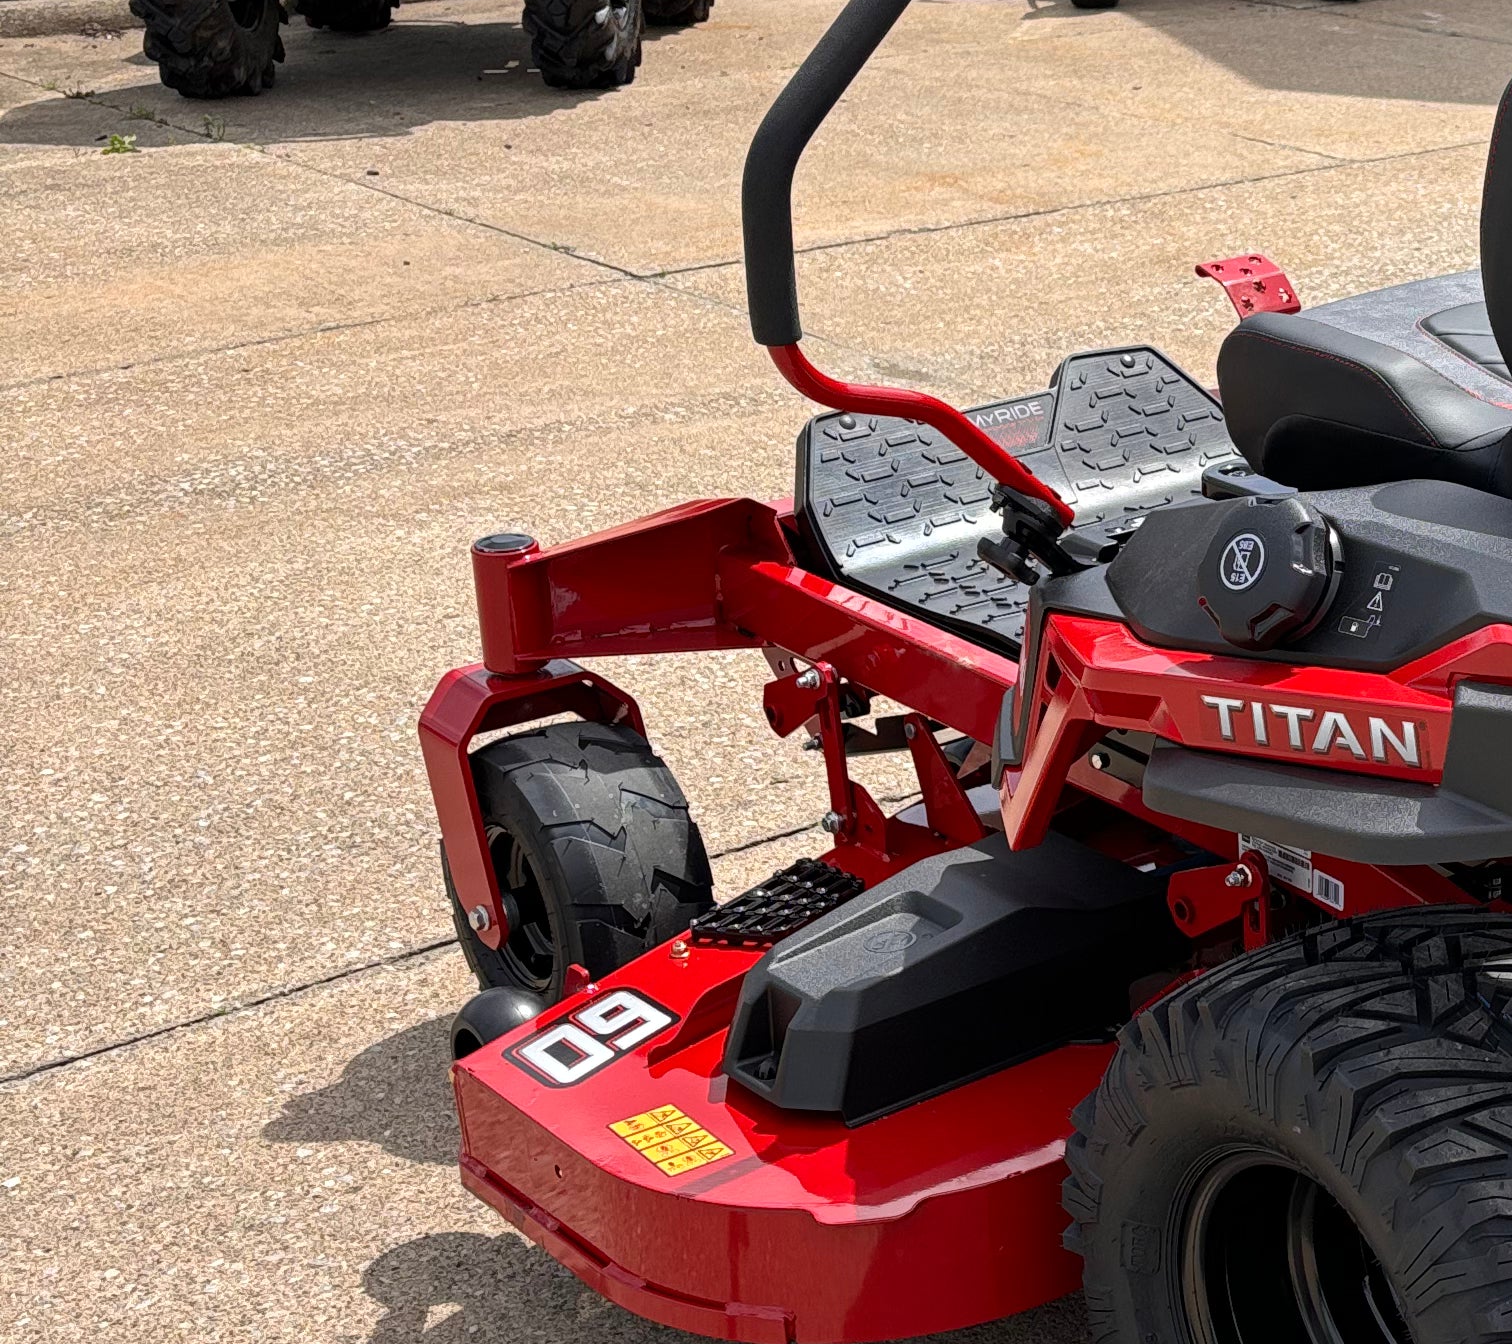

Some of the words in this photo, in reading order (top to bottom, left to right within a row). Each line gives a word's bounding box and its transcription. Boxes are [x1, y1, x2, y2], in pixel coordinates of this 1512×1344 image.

[1230, 572, 1246, 583] E15
[1200, 694, 1421, 767] TITAN
[519, 990, 672, 1084] 60
